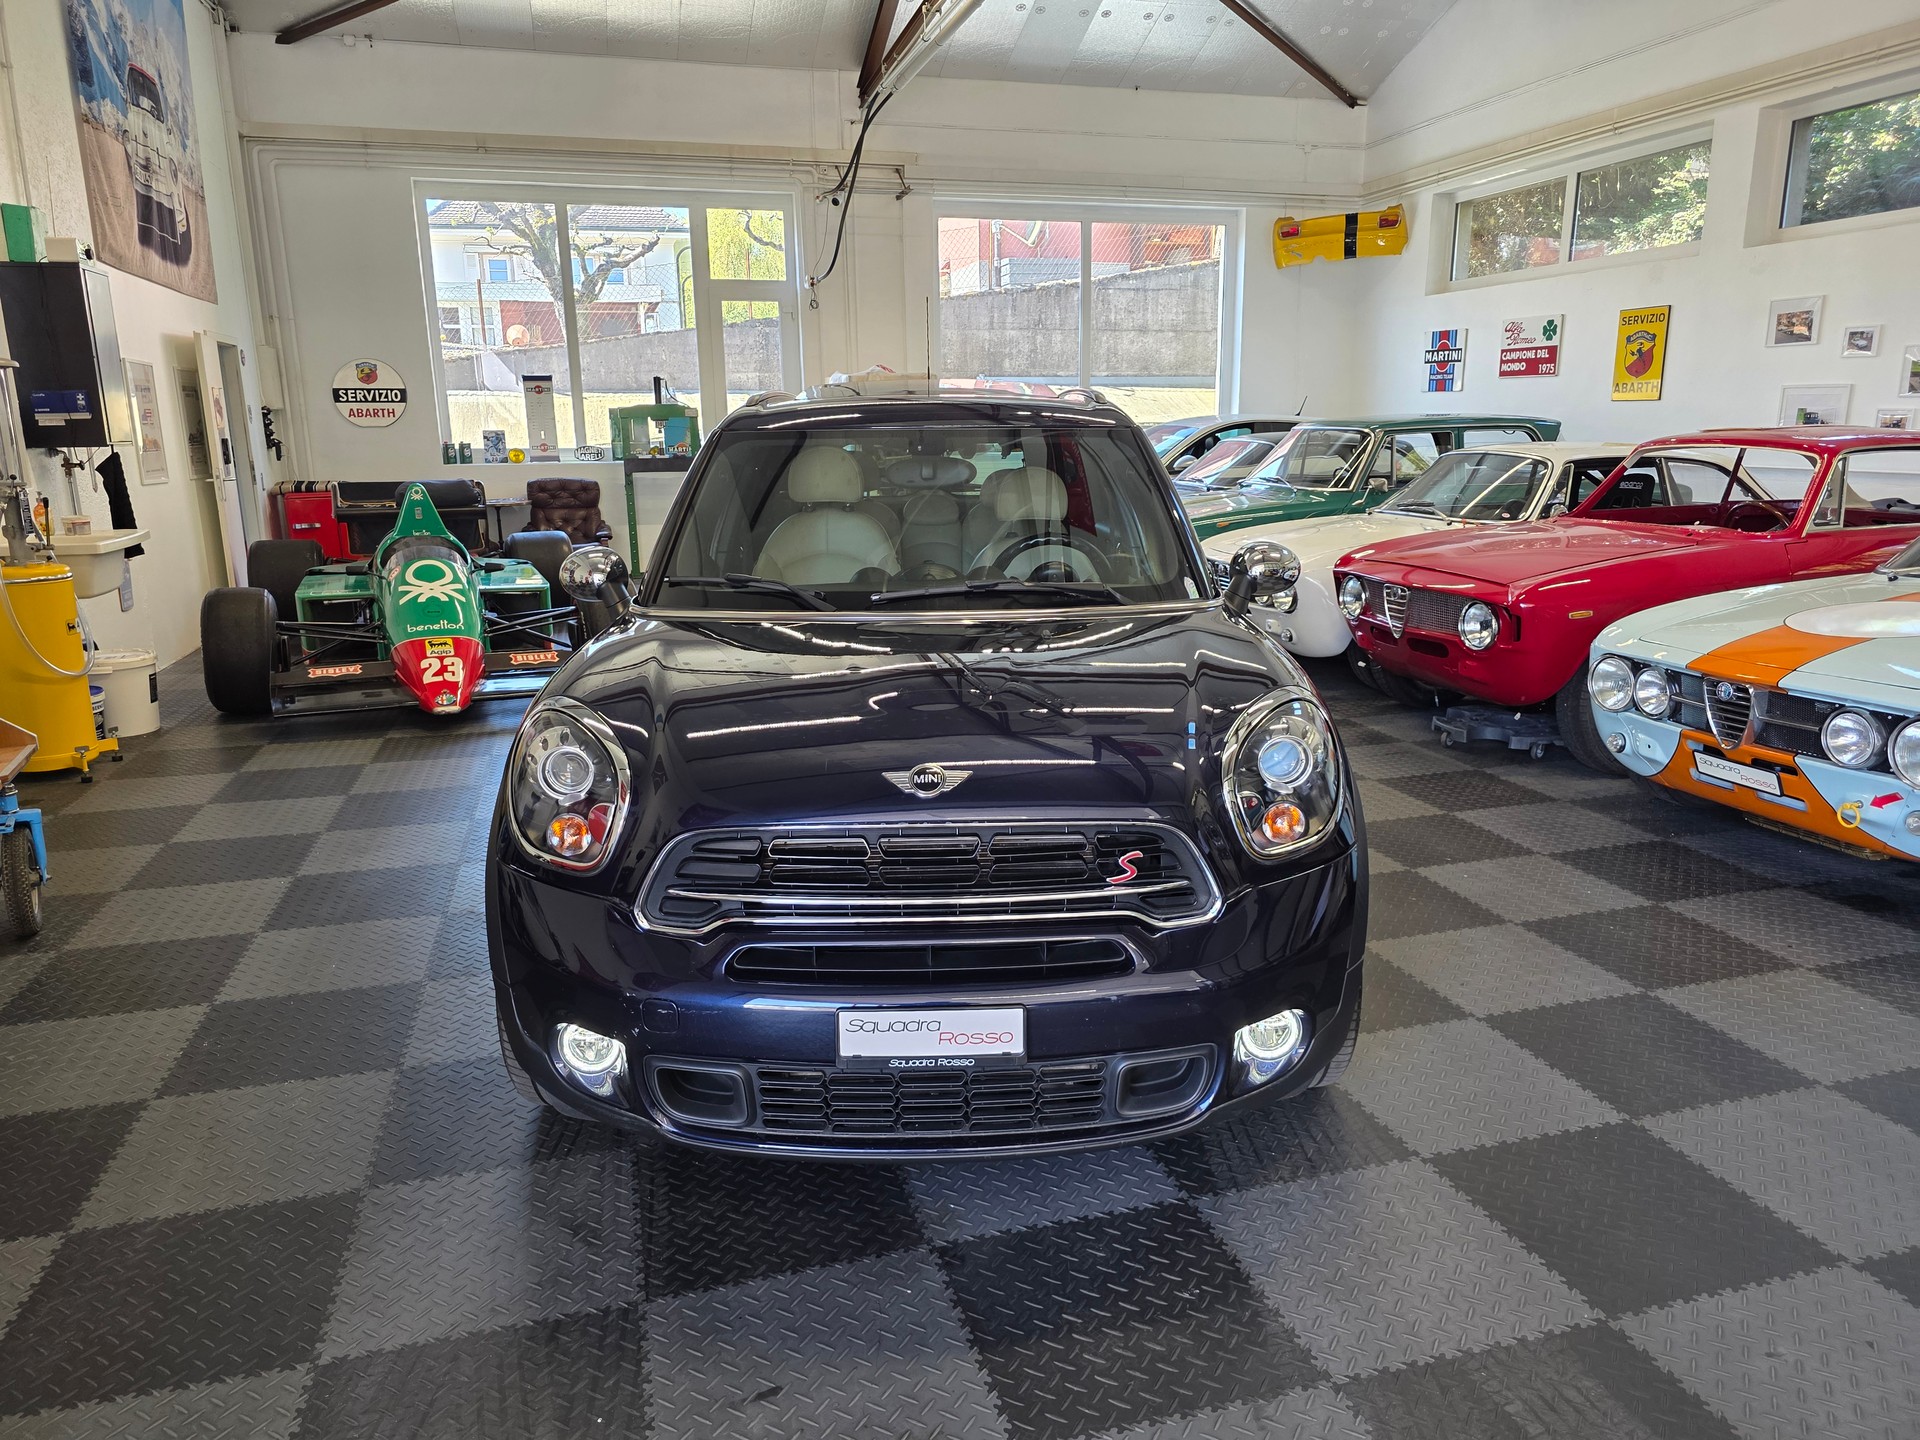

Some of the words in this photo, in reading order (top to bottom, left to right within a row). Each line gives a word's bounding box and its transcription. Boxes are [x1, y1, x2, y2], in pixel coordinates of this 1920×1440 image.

[1621, 312, 1666, 326] SERVIZIO
[1504, 321, 1525, 333] Alfa
[1506, 332, 1536, 346] Romeo
[1425, 350, 1462, 362] MARTINI
[1501, 350, 1536, 360] CAMPIONE
[1536, 348, 1550, 358] DEL
[1500, 361, 1526, 371] MONDO
[1538, 363, 1555, 374] 1975
[1612, 381, 1659, 393] ABARTH
[338, 389, 401, 402] SERVIZIO
[348, 407, 396, 418] ABARTH
[407, 620, 465, 633] benetton
[516, 653, 552, 661] SISLEY
[315, 666, 355, 675] SISLEY
[420, 656, 464, 685] 23
[1698, 757, 1741, 775] Squadra
[913, 774, 942, 784] MINI
[1106, 850, 1144, 884] S
[845, 1018, 942, 1034] Squadra
[888, 1058, 935, 1068] Squadra
[937, 1058, 975, 1067] Rosso
